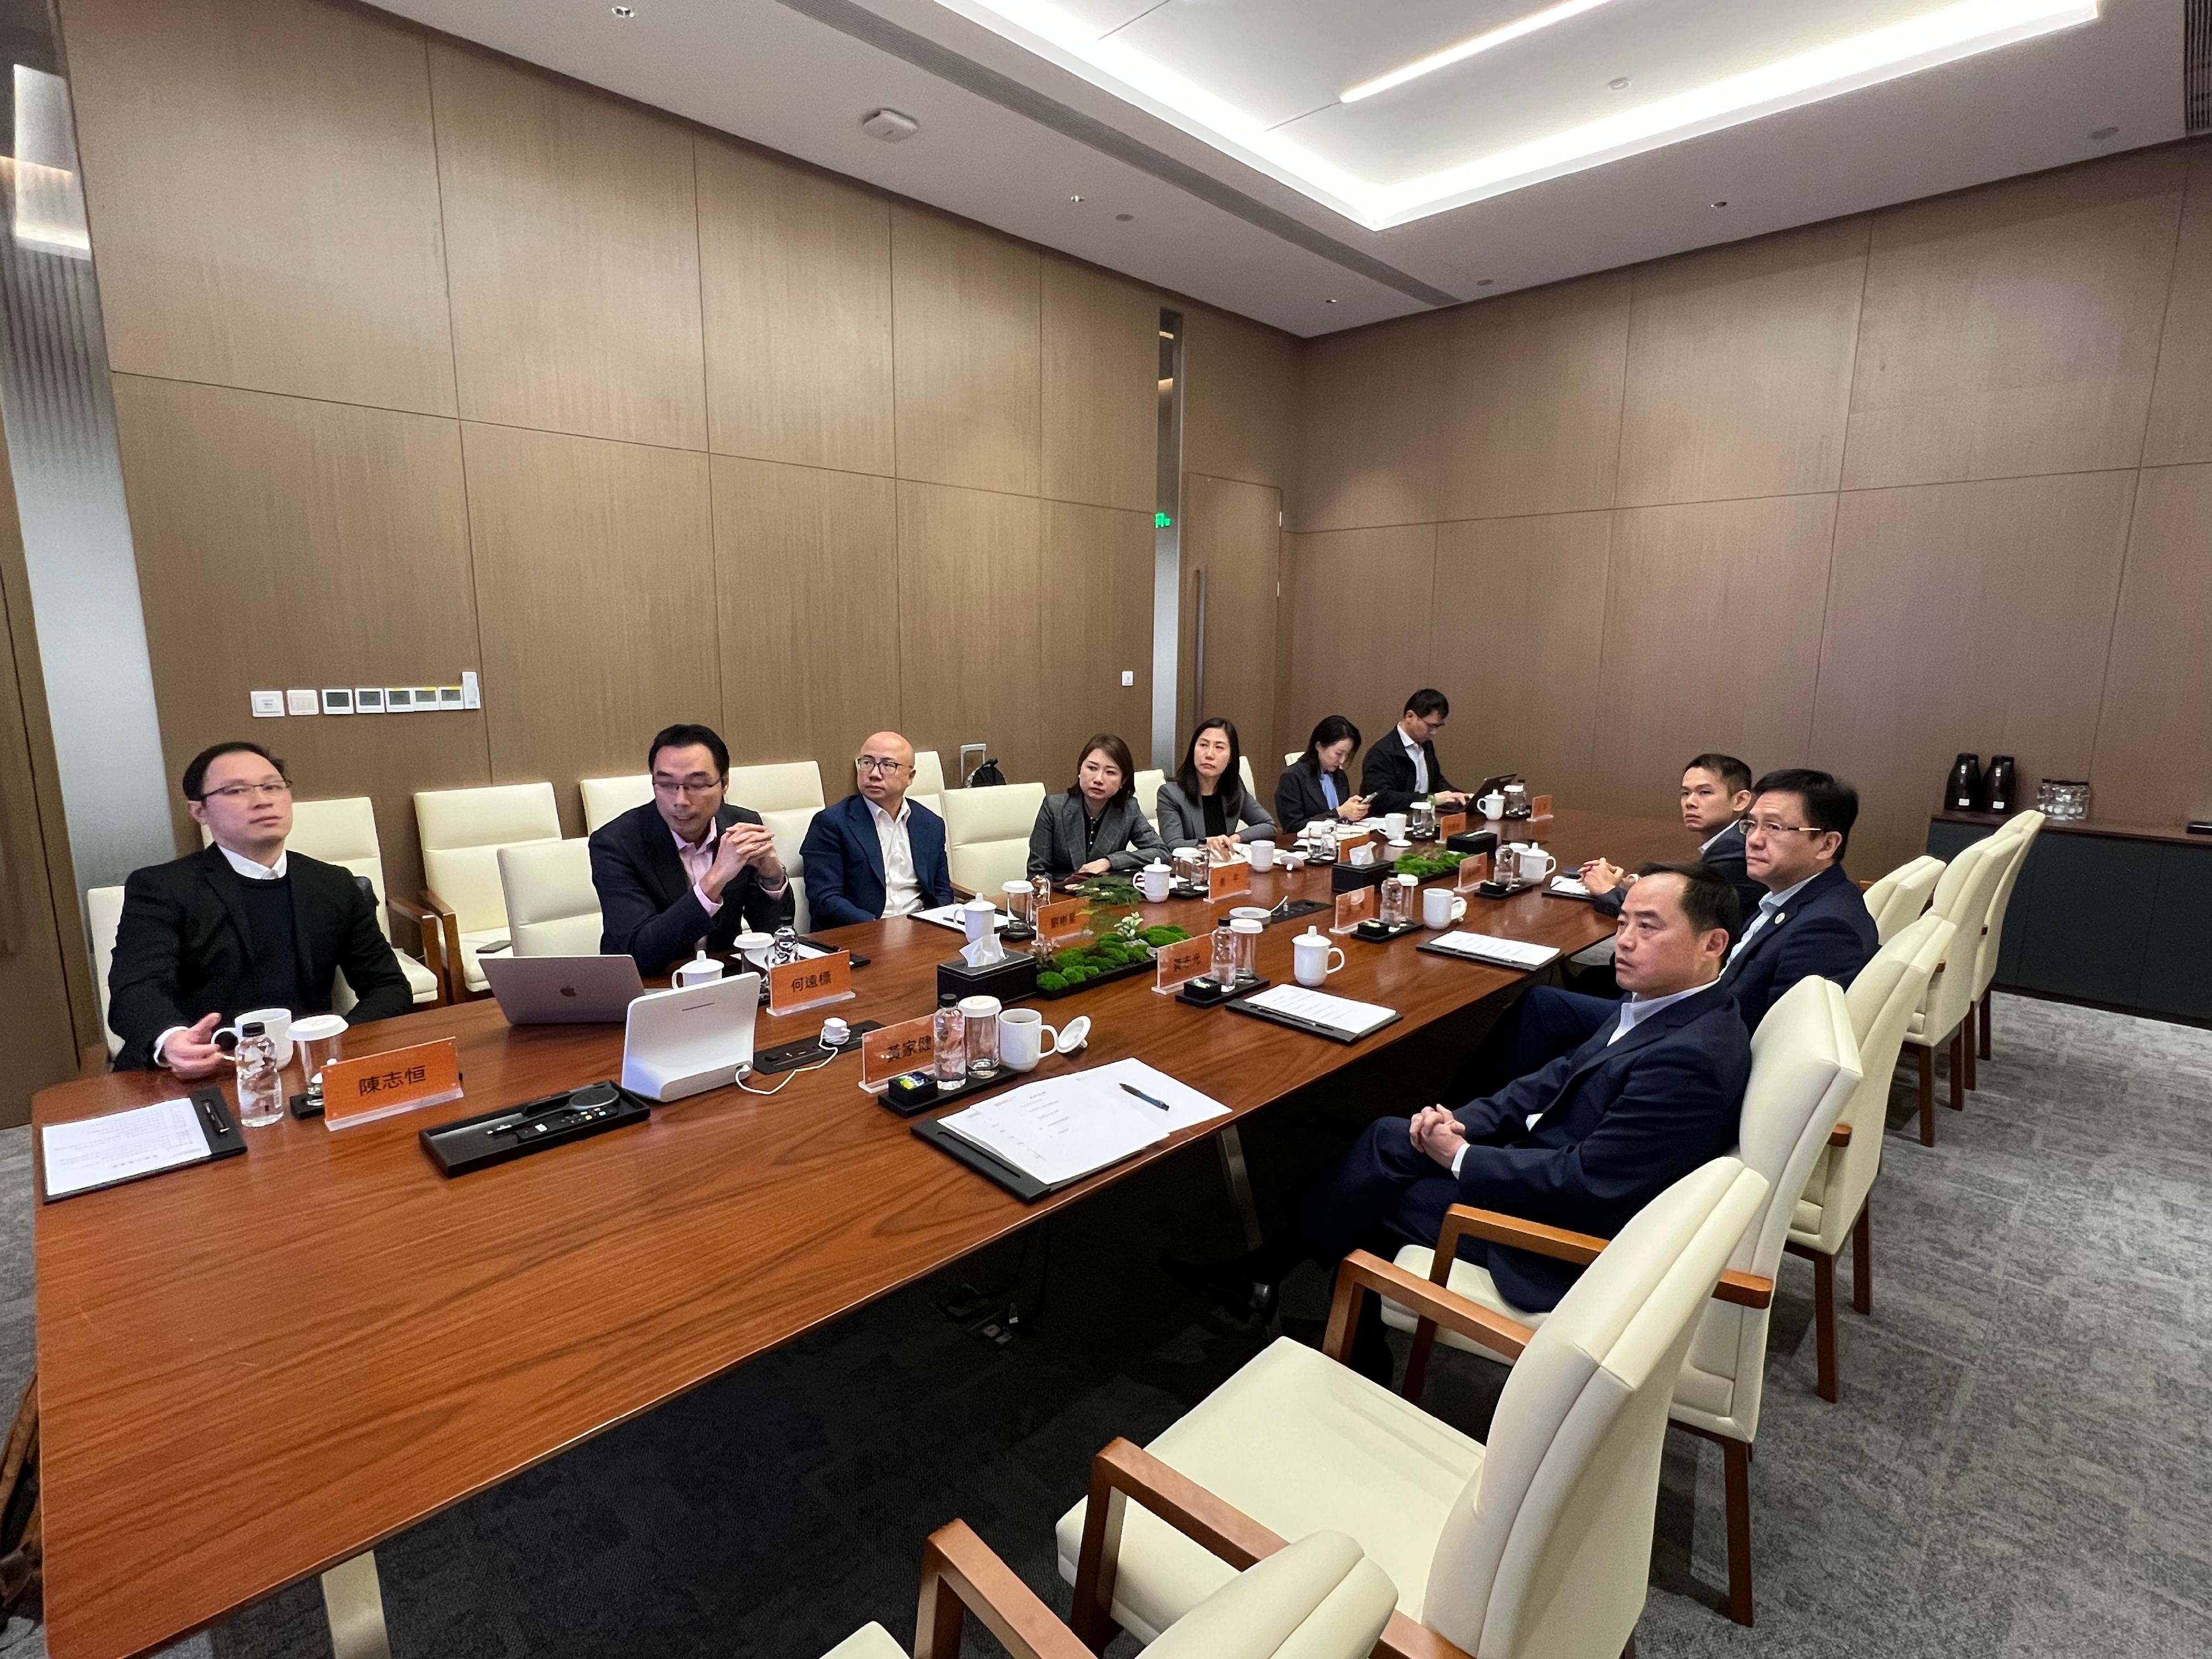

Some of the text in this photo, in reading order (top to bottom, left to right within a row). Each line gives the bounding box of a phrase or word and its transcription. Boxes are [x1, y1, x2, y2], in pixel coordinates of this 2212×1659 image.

[791, 971, 832, 993] 何遠標
[886, 1035, 932, 1063] 黃家健
[358, 1065, 427, 1097] 陳志恒
